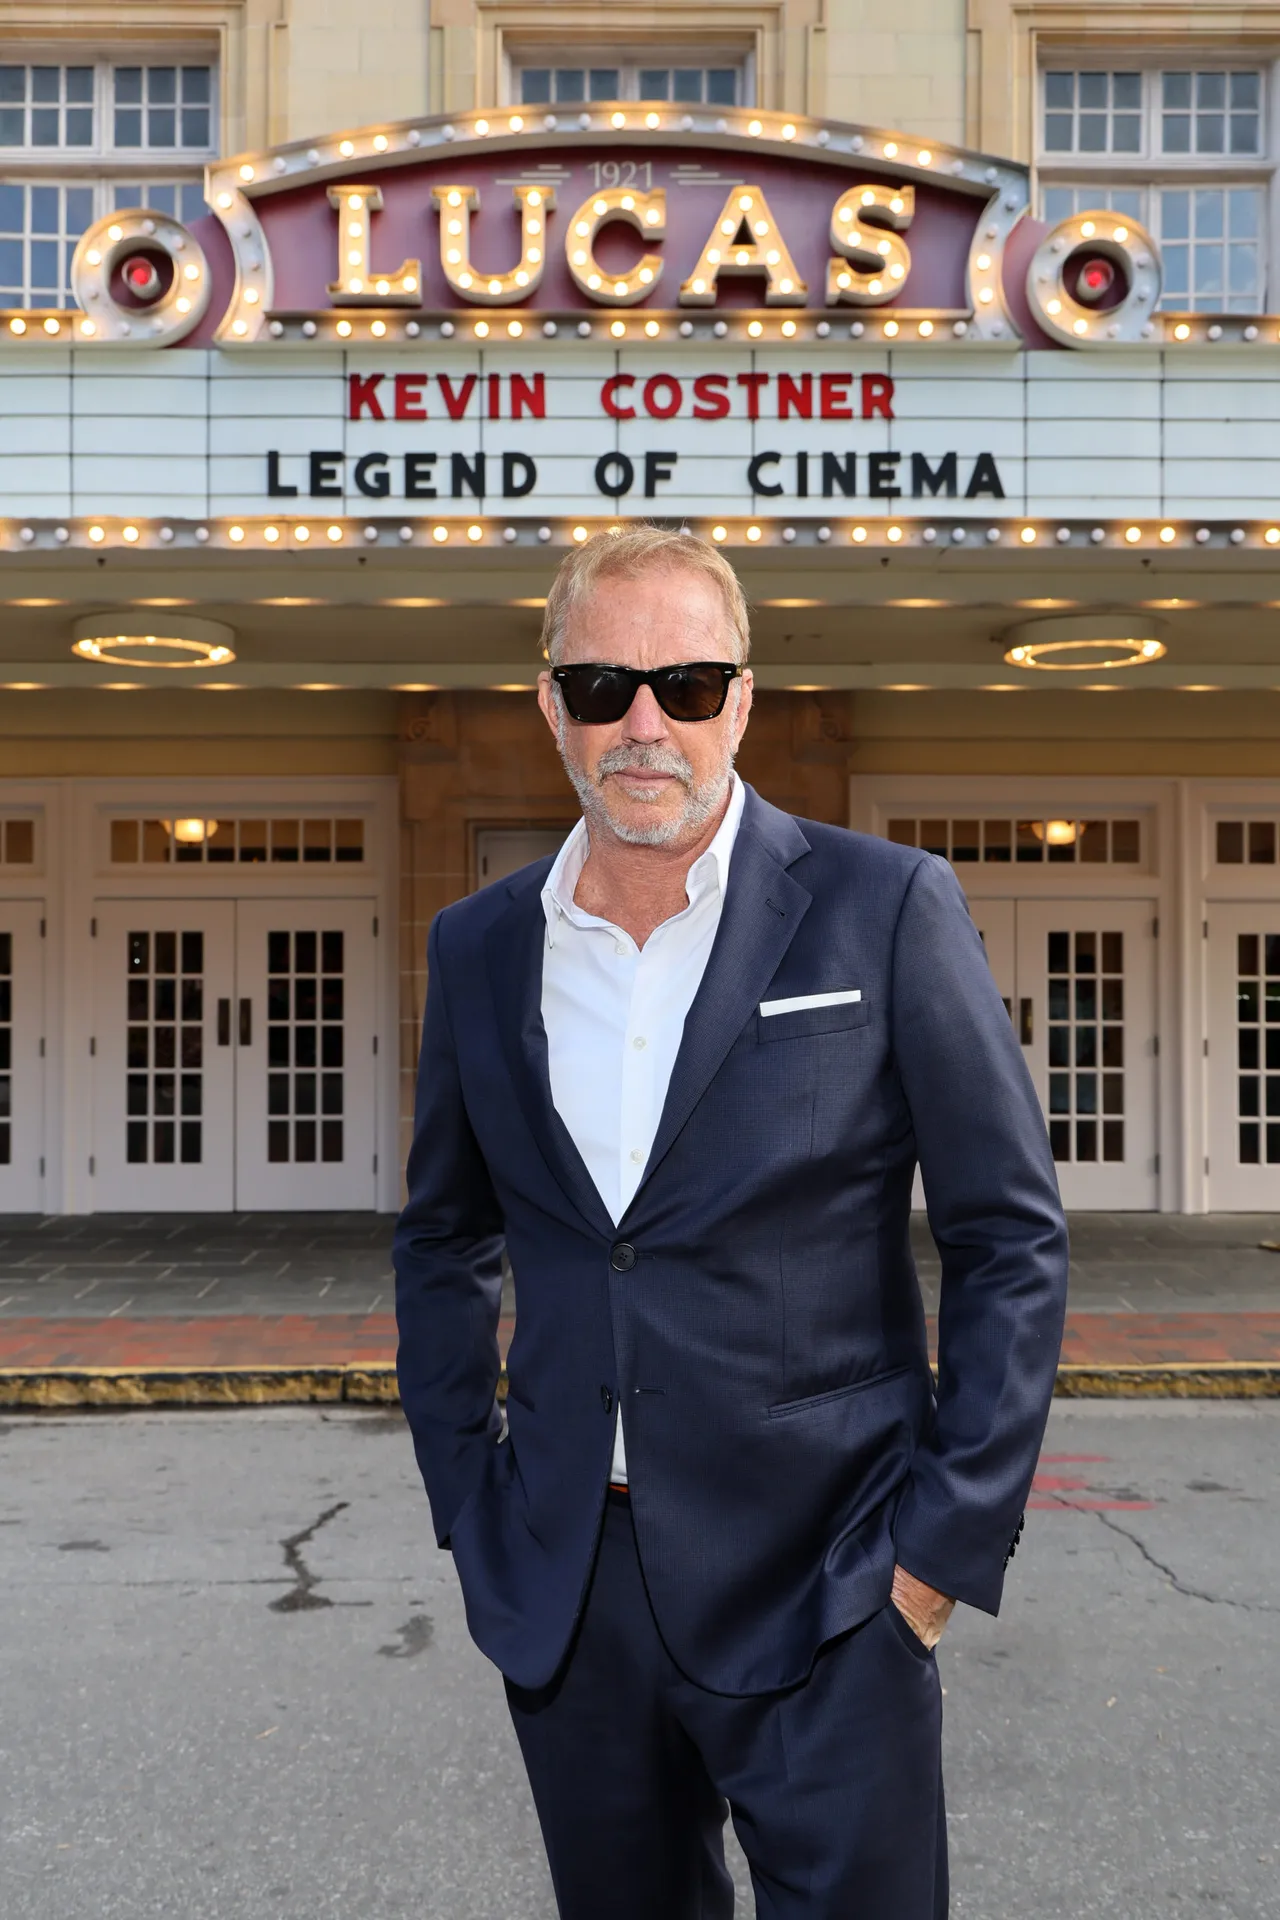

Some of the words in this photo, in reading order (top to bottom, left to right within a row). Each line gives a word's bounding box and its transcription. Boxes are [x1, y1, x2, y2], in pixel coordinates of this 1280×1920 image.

[587, 161, 652, 189] 1921
[326, 184, 916, 307] LUCAS
[349, 373, 545, 420] KEVIN
[601, 373, 895, 420] COSTNER
[267, 451, 537, 499] LEGEND
[594, 451, 678, 498] OF
[747, 451, 1005, 499] CINEMA
